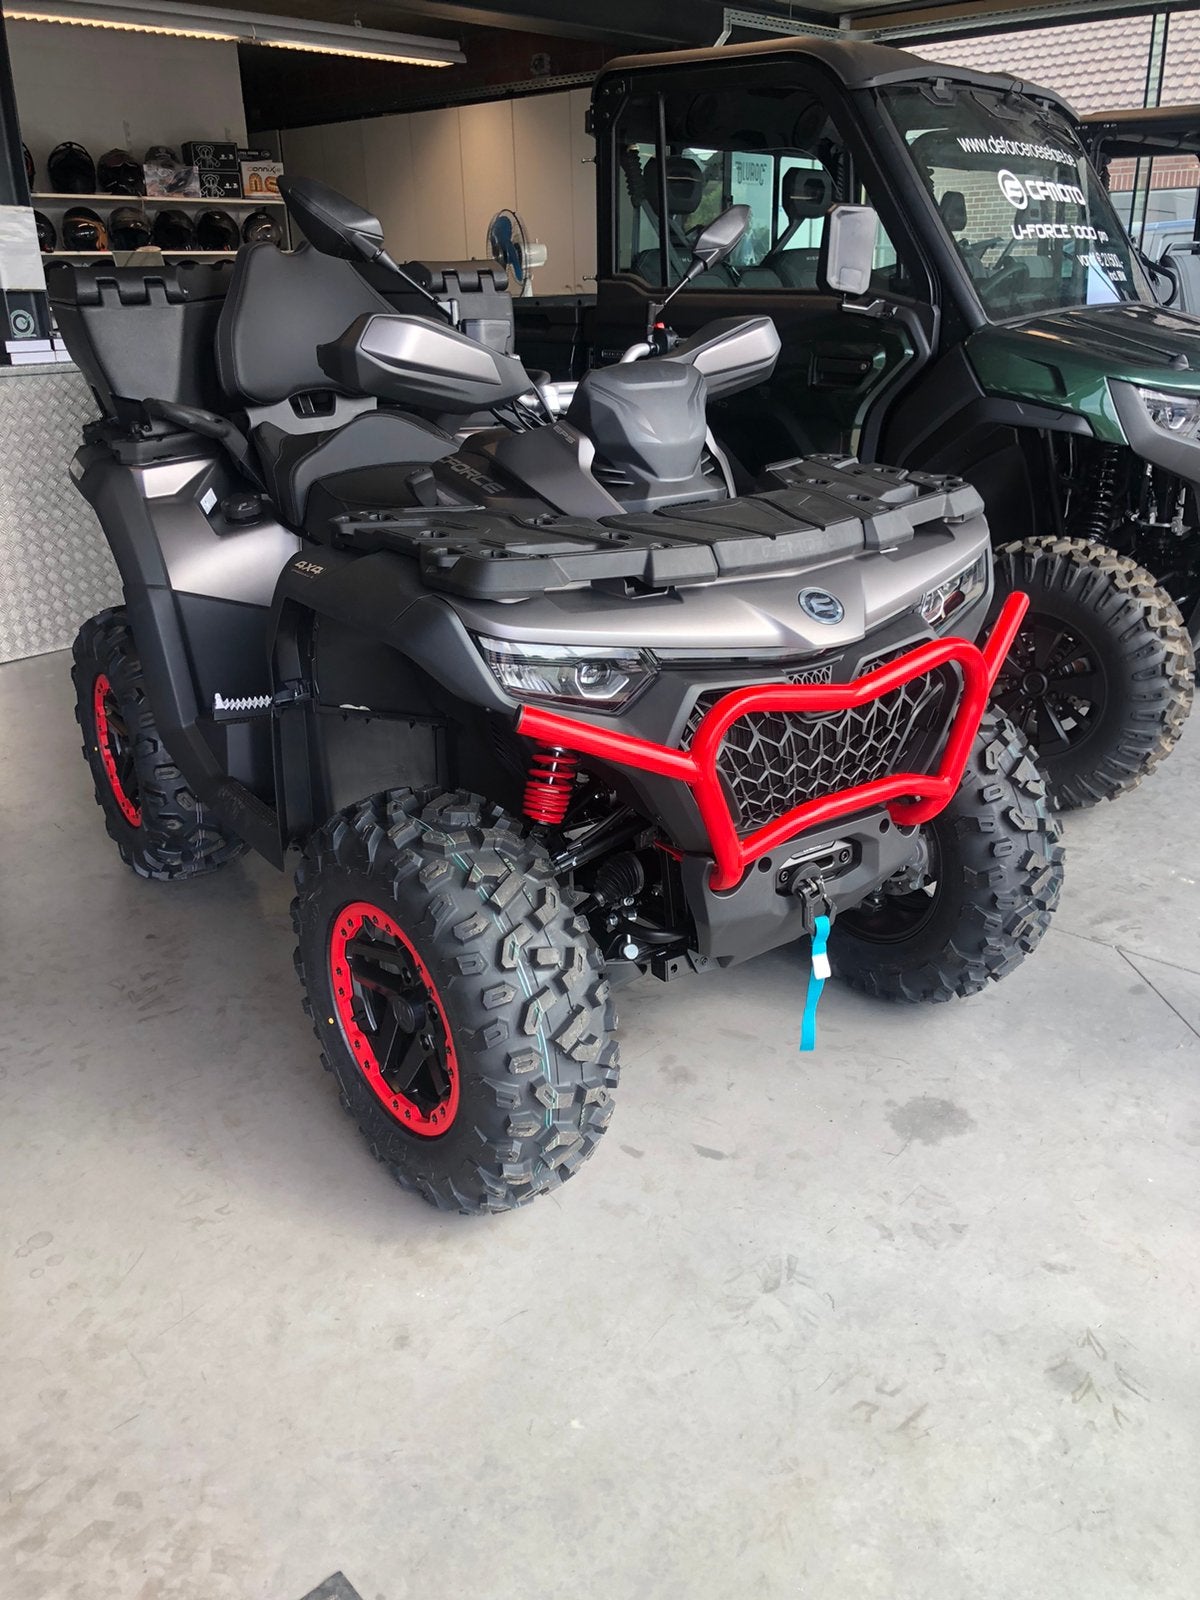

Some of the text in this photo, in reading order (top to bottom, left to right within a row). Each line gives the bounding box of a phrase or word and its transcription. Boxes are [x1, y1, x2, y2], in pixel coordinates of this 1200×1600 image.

[1025, 180, 1086, 205] CFMOTO
[1011, 224, 1071, 240] U-FORCE
[1071, 225, 1097, 240] 1000
